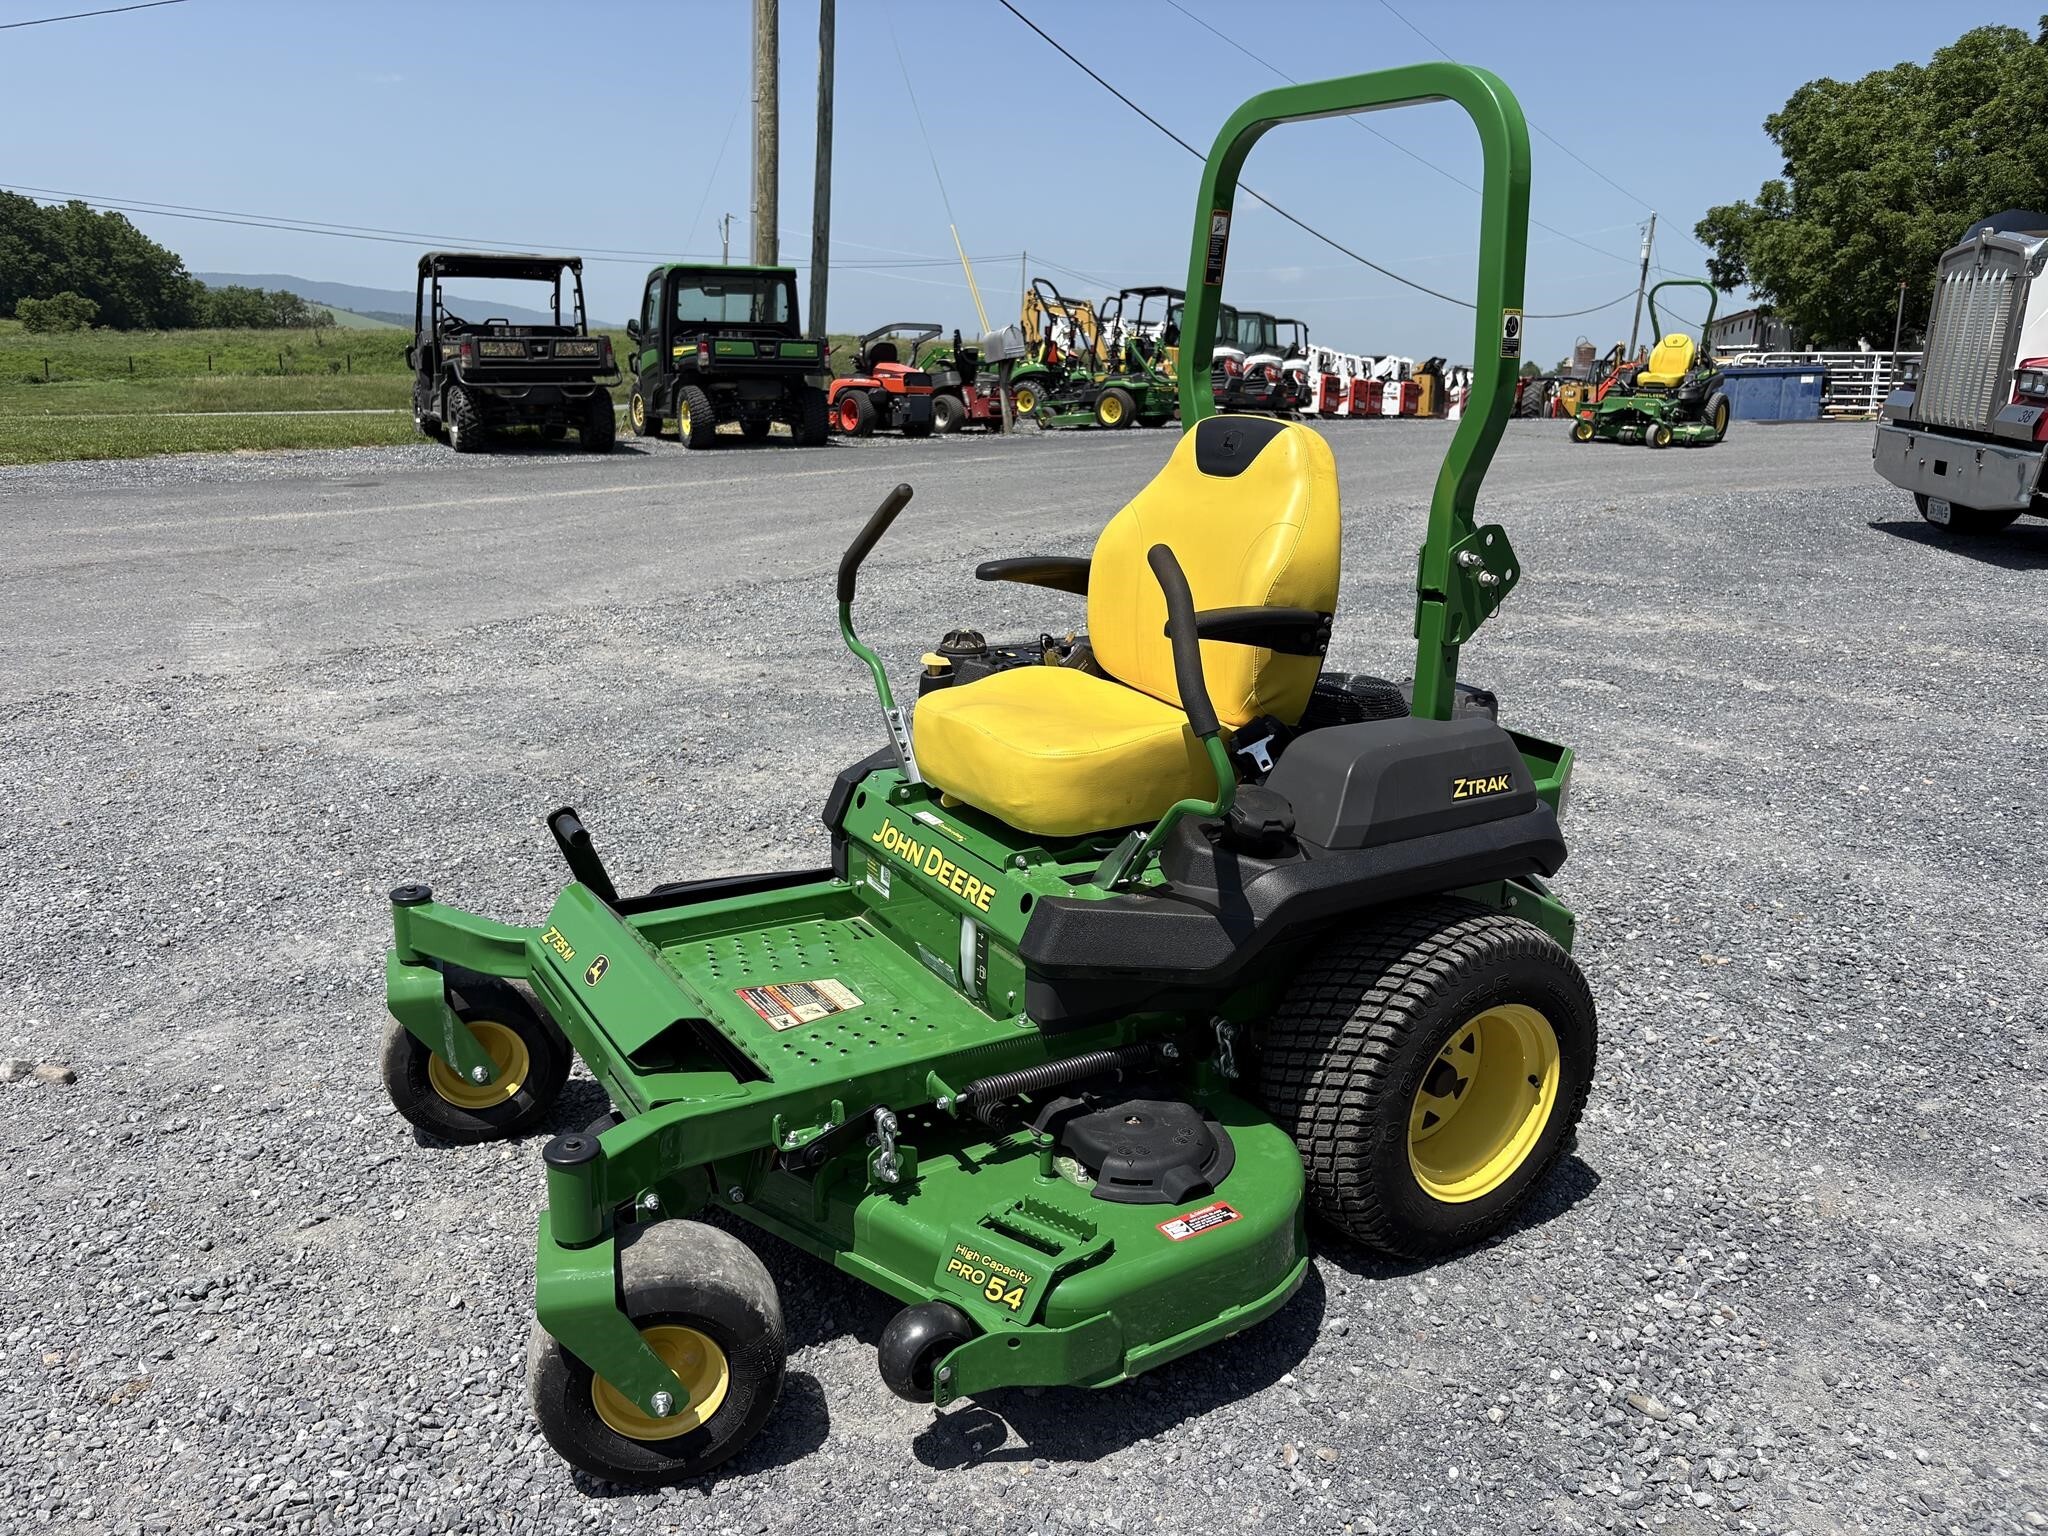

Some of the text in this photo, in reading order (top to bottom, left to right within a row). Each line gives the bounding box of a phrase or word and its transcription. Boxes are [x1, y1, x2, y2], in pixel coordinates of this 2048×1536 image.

[2017, 410, 2034, 423] 38
[1453, 774, 1509, 799] ZTRAK
[872, 817, 925, 869] JOHN
[923, 846, 997, 913] DEERE
[541, 925, 577, 963] Z735M
[955, 1243, 1033, 1285] High Capacity
[946, 1257, 1026, 1312] PRO 54
